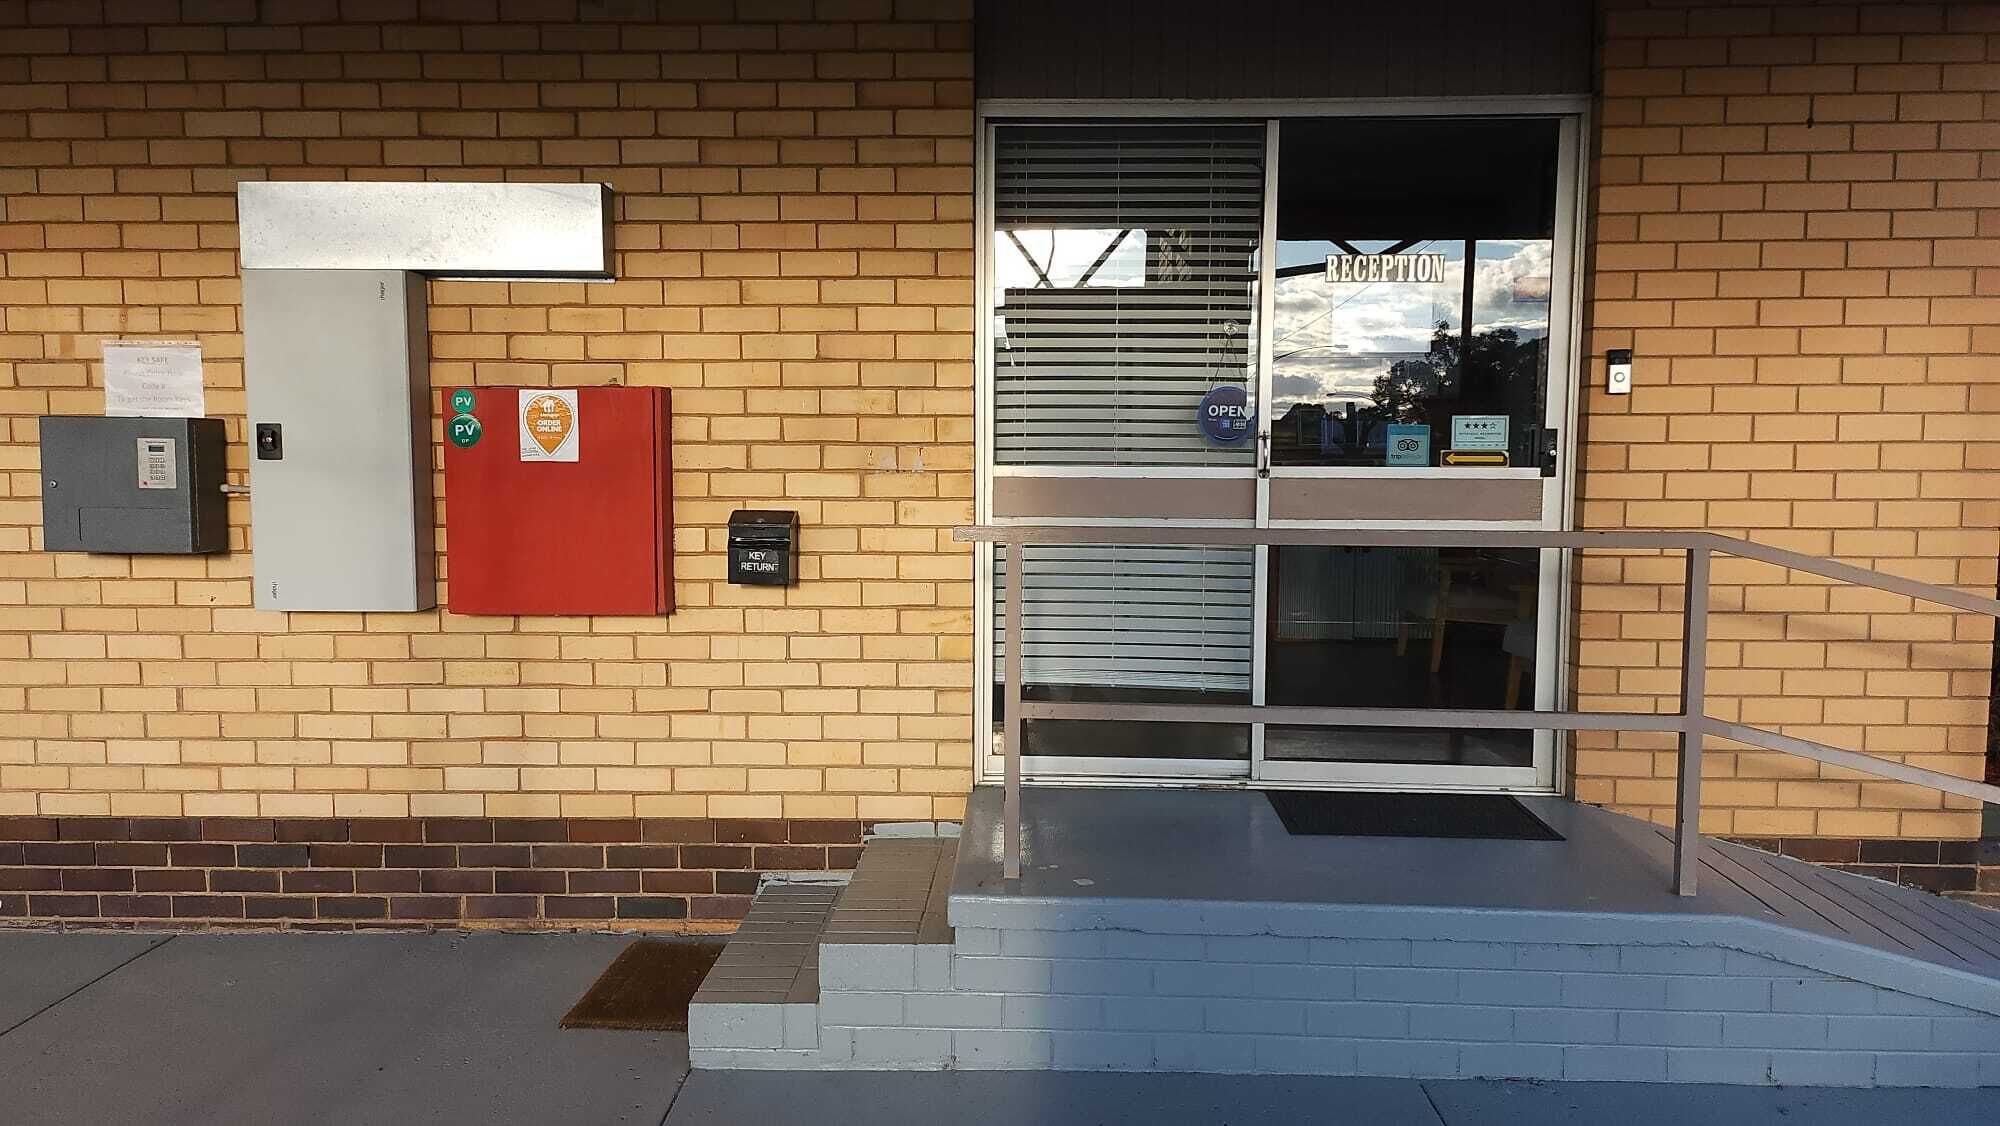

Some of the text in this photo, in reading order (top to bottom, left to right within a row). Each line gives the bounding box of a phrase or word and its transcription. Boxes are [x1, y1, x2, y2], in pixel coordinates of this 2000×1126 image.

[1325, 254, 1445, 282] RECEPTION
[455, 396, 472, 406] PV
[1208, 404, 1248, 417] OPEN
[455, 424, 475, 436] PV
[749, 552, 766, 560] KEY
[741, 562, 775, 571] RETURN
